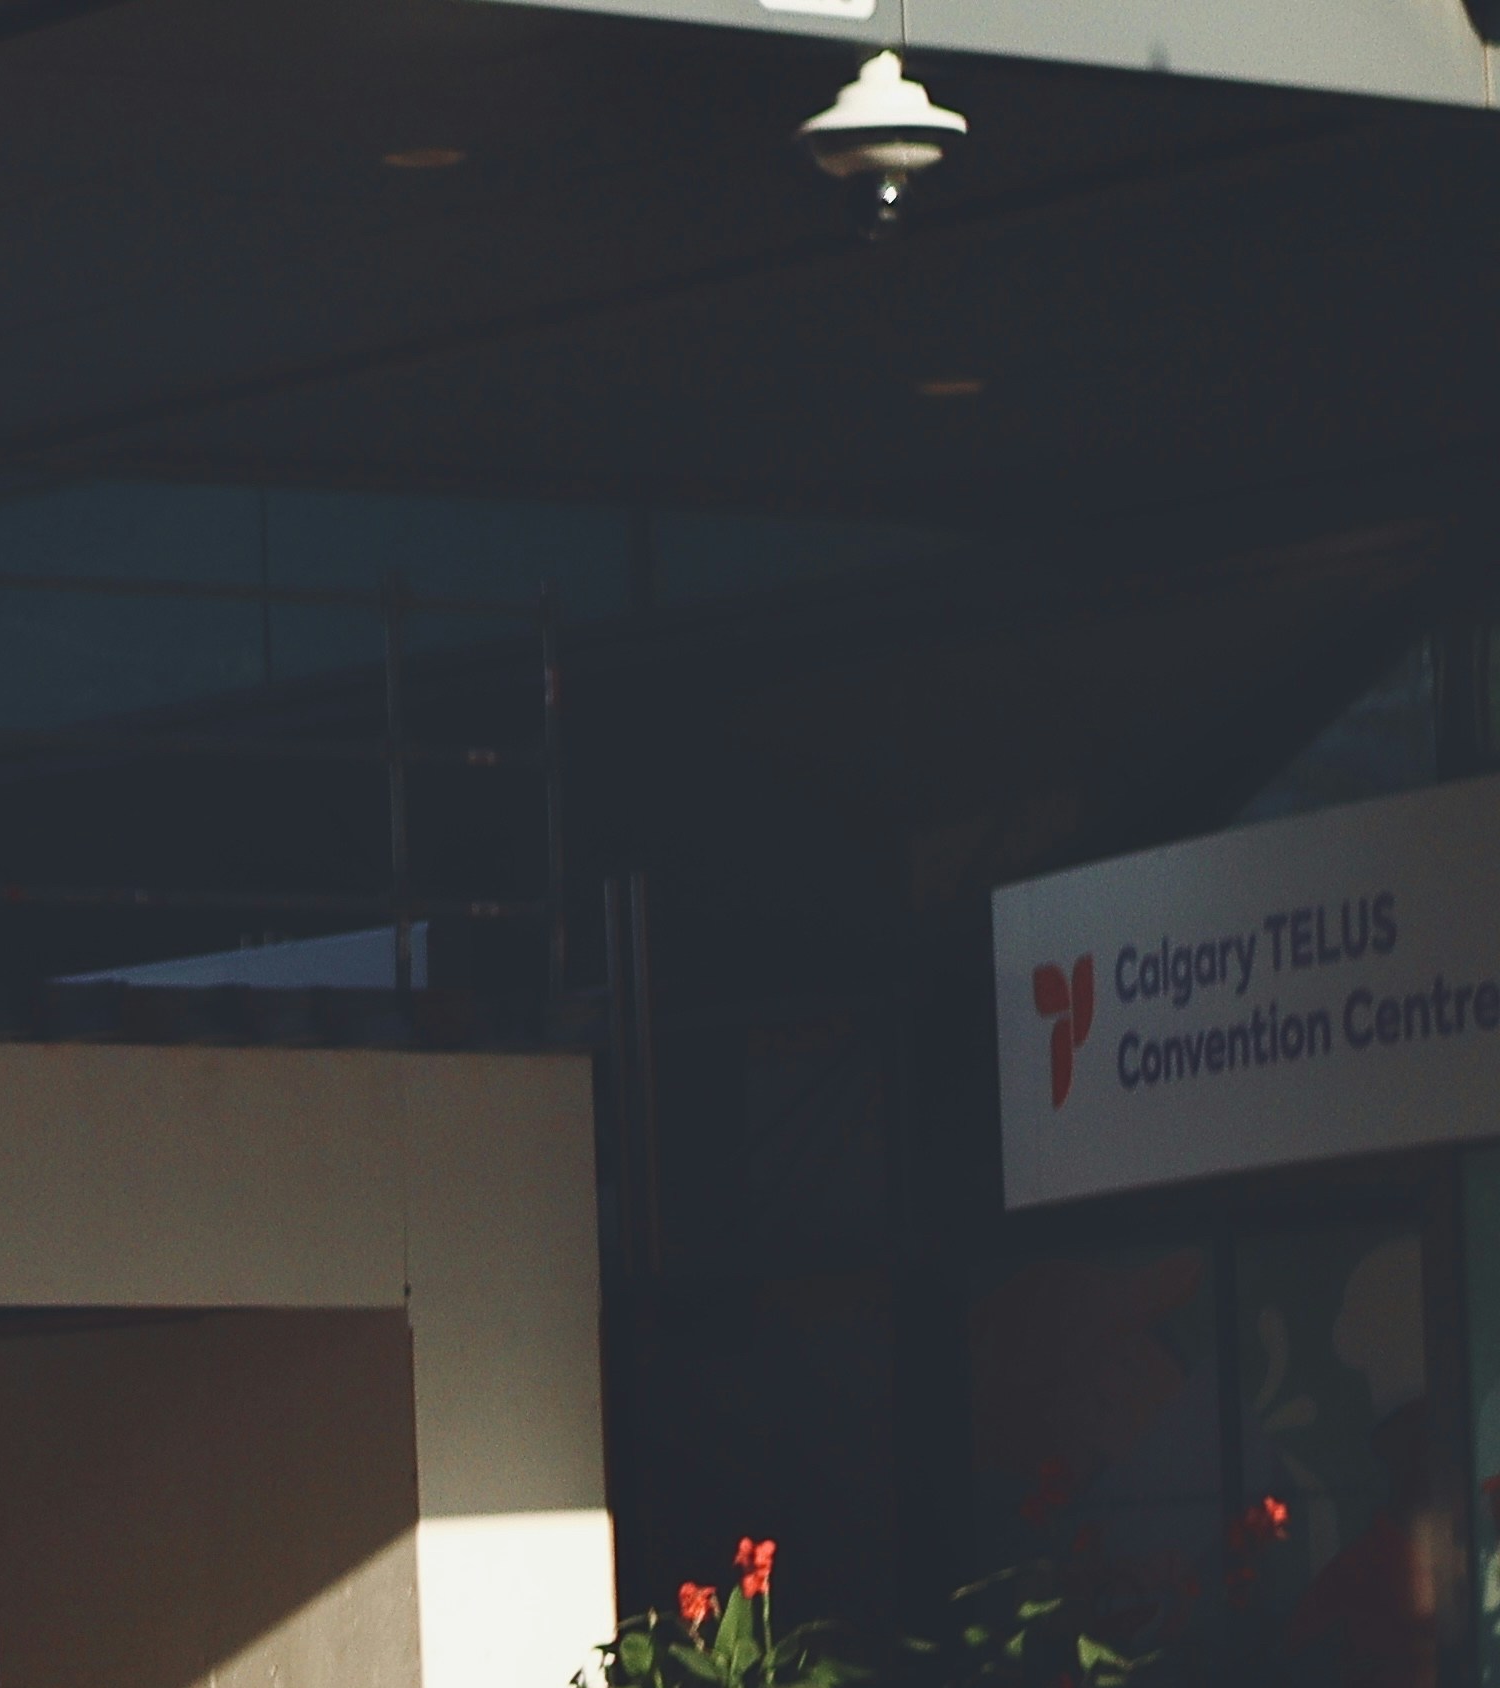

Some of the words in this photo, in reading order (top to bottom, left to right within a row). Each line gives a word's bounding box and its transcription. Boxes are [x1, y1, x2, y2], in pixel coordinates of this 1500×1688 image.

[1114, 935, 1256, 1006] Calgary
[1263, 891, 1397, 972] TELUS
[1116, 1001, 1333, 1090] Convention
[1342, 972, 1500, 1050] Centre
